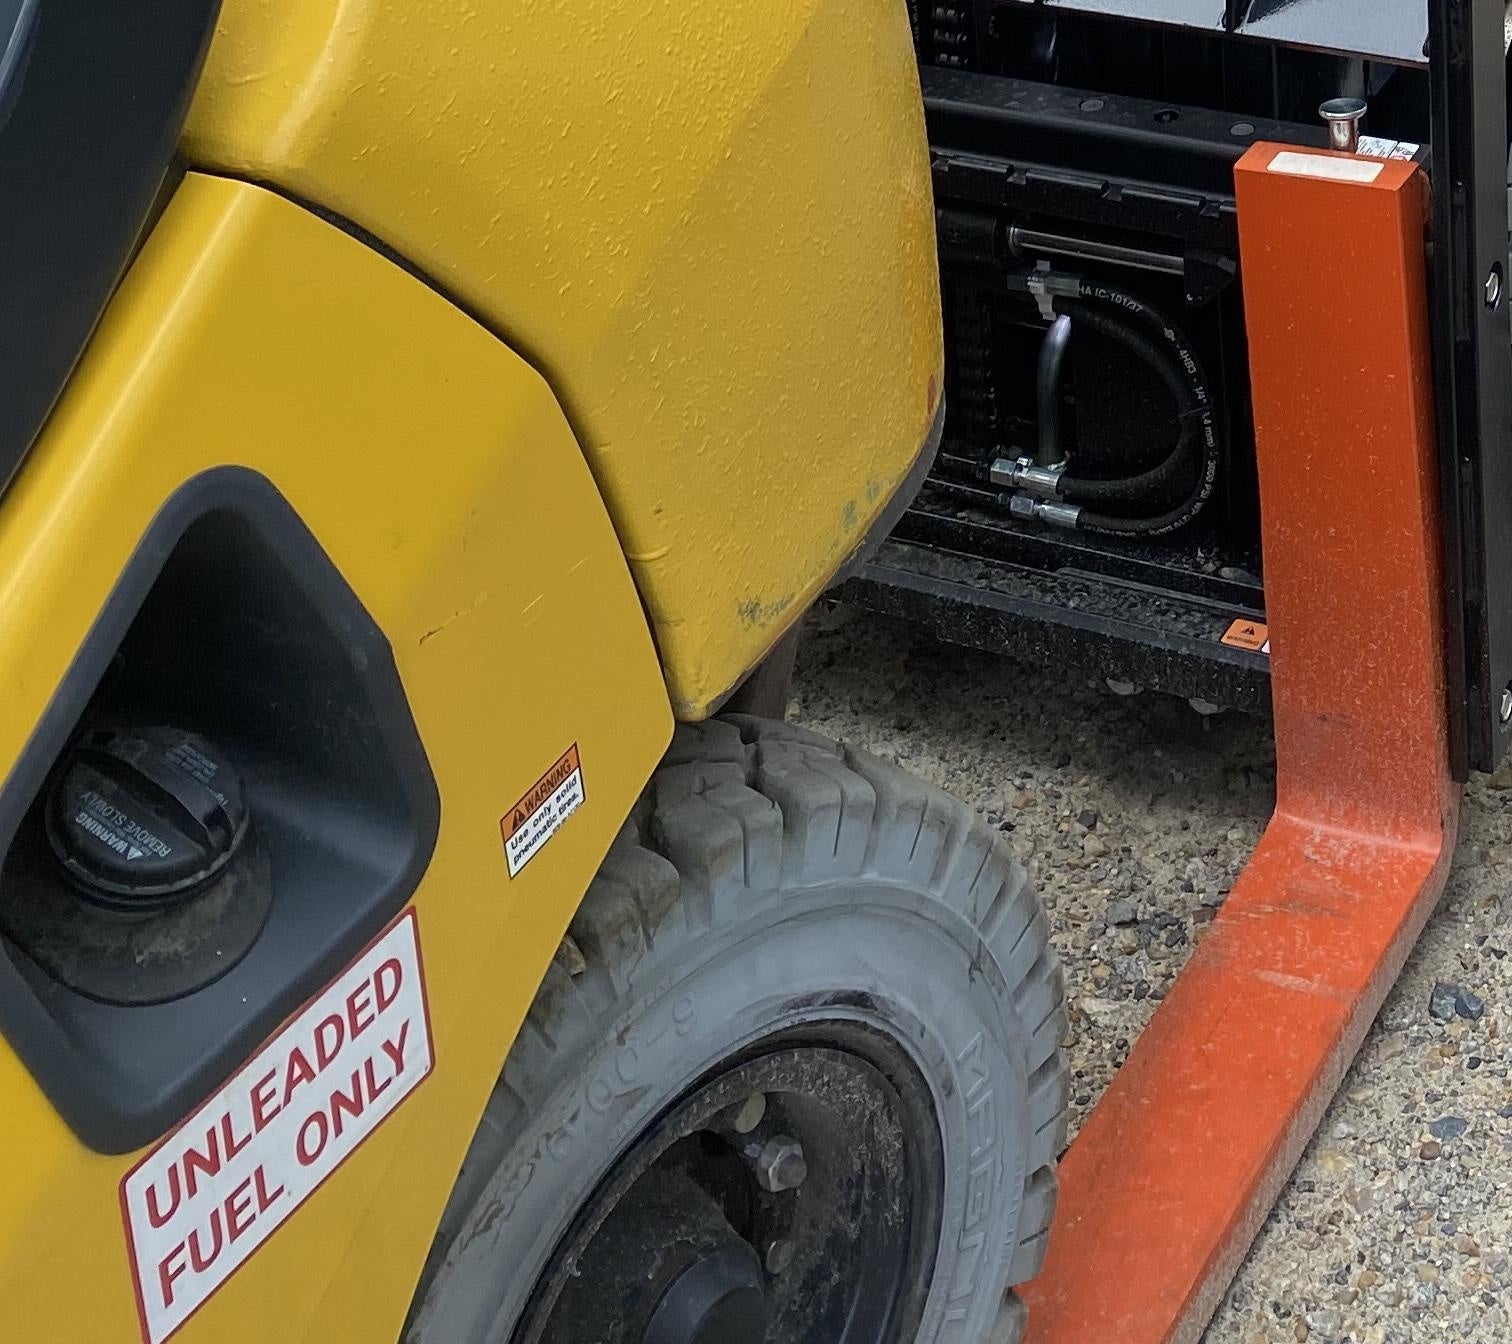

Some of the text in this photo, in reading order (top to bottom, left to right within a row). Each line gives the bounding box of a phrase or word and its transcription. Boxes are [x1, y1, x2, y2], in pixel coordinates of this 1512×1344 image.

[80, 790, 129, 827] SLOWLY
[510, 775, 578, 851] Use only solid
[524, 758, 572, 813] WARNING
[74, 811, 129, 855] WARNING
[125, 820, 172, 859] REMOVE
[513, 812, 558, 867] pneumatic
[144, 957, 403, 1229] UNLEADED
[157, 1018, 411, 1310] FUEL ONLY
